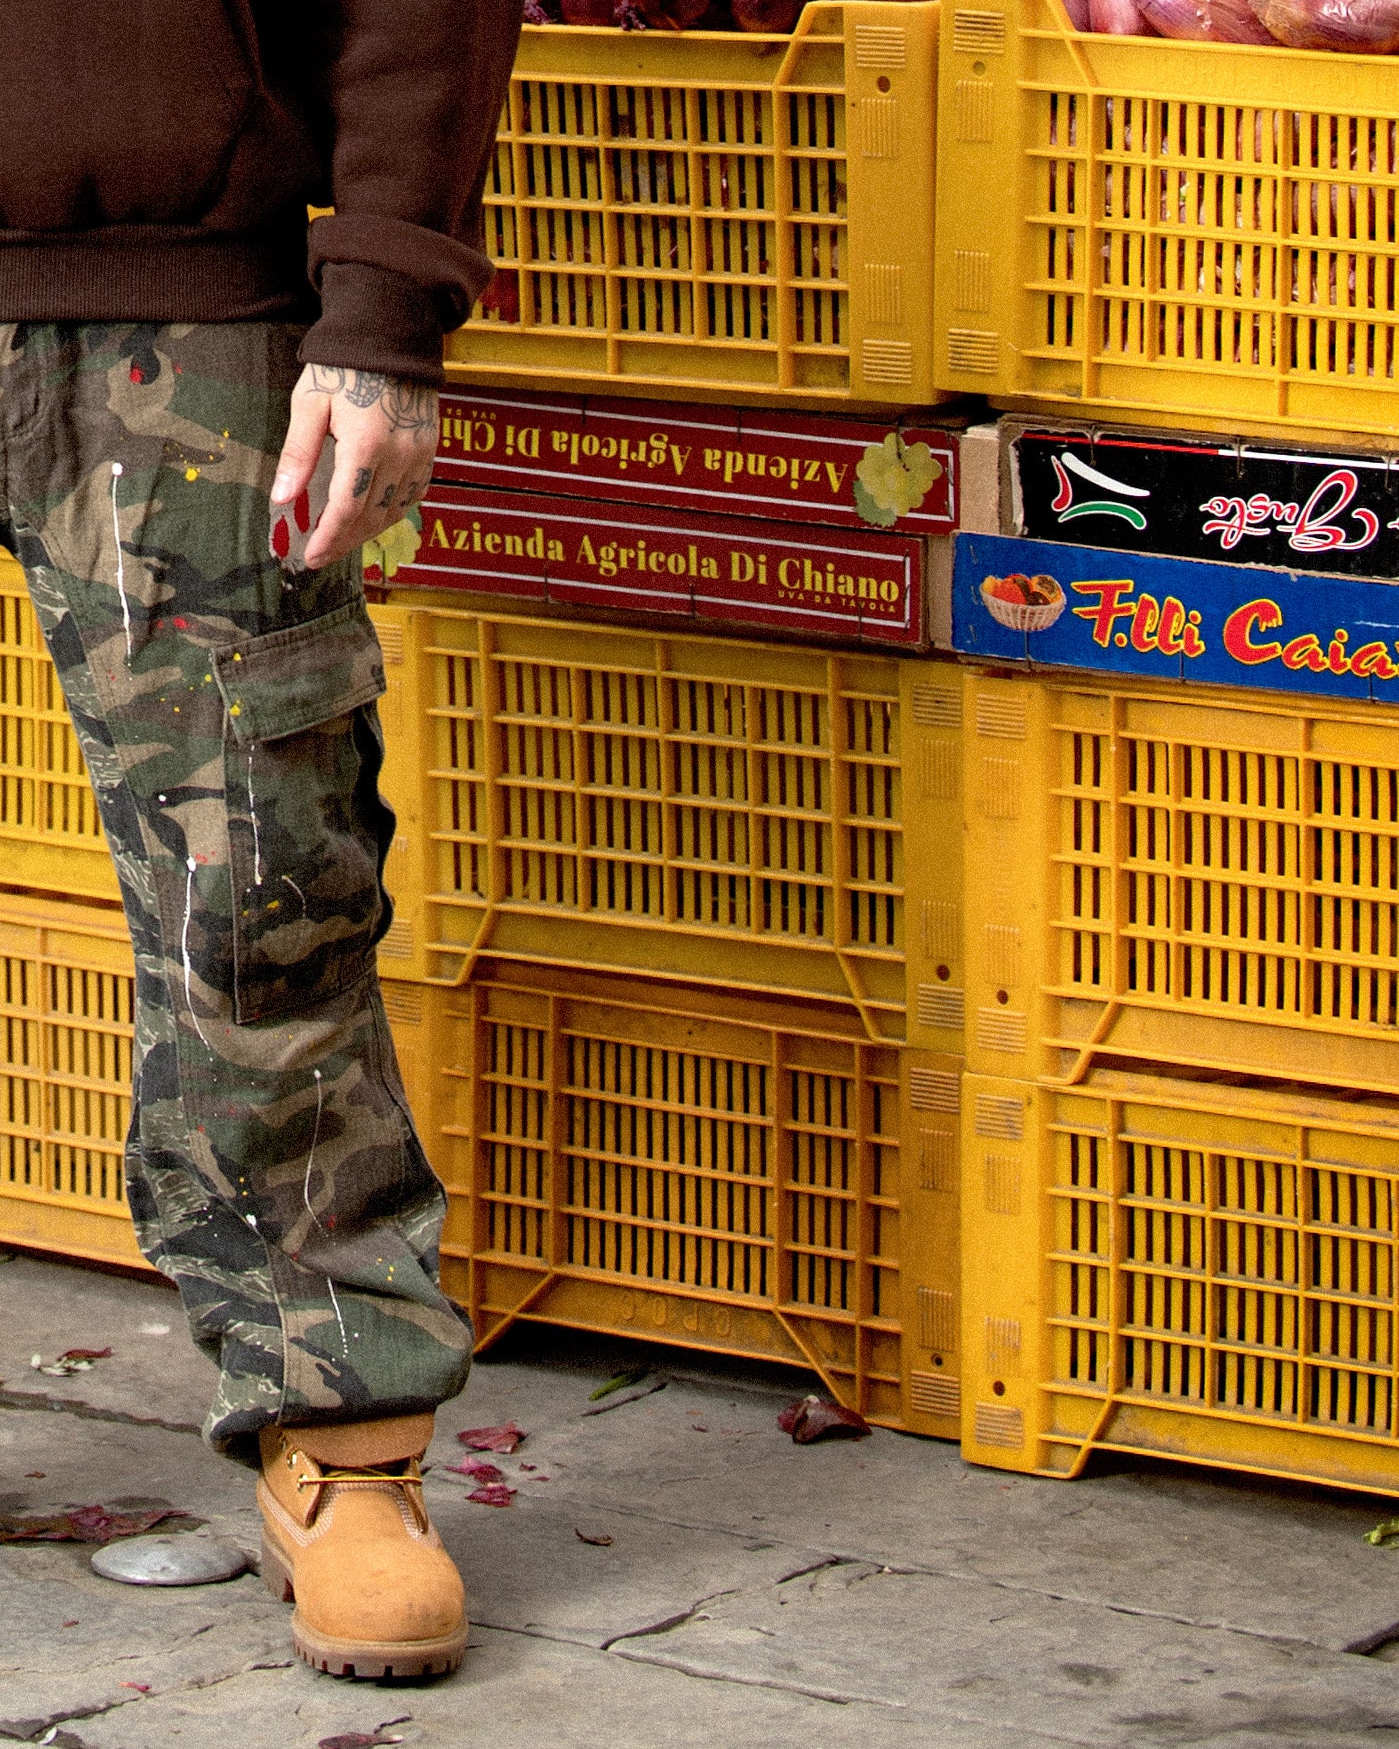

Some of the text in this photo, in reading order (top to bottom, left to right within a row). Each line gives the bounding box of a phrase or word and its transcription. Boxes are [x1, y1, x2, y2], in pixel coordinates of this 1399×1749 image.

[442, 417, 847, 493] Azienda Agricola Di Chi
[1199, 468, 1380, 553] Gusto
[428, 518, 900, 602] Azienda Agricola Di Chiano
[778, 589, 897, 613] UVA DA TAVOLA
[1070, 579, 1399, 679] F.lli Caia
